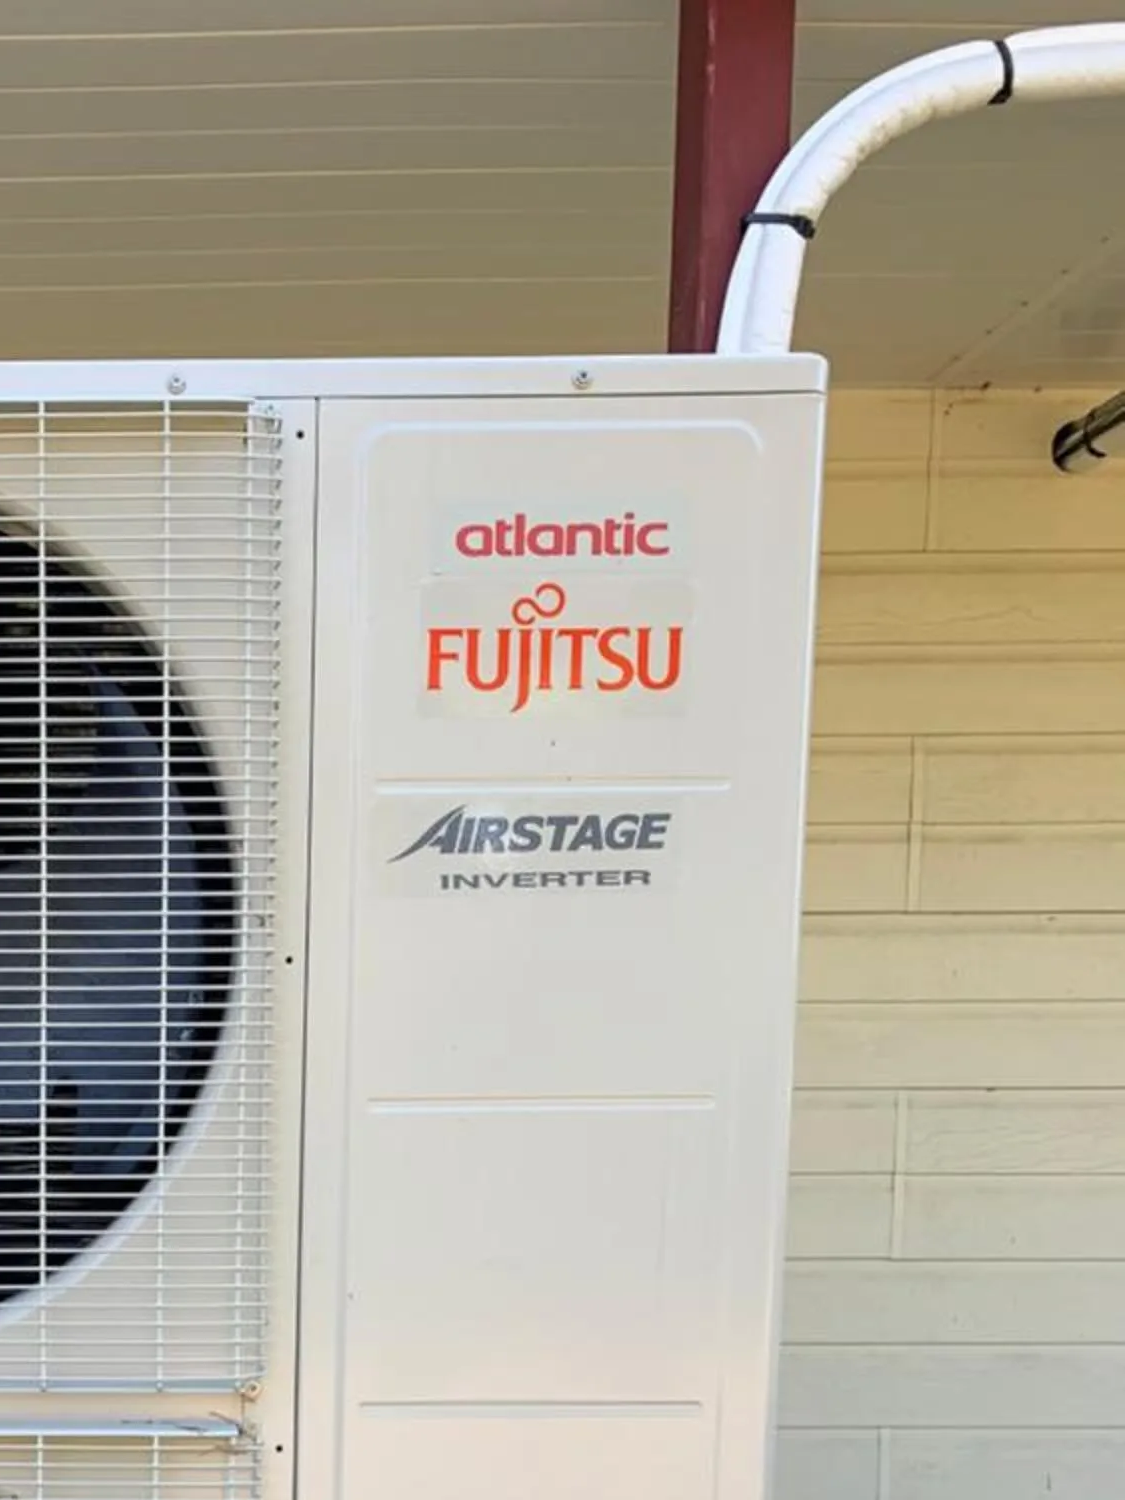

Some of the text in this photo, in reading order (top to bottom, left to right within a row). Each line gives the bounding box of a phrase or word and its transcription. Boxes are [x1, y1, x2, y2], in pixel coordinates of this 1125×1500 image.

[455, 513, 670, 556] atlantic
[426, 583, 683, 713] FUJITSU
[388, 805, 671, 862] AIRSTAGE
[439, 870, 651, 890] INVERTER
